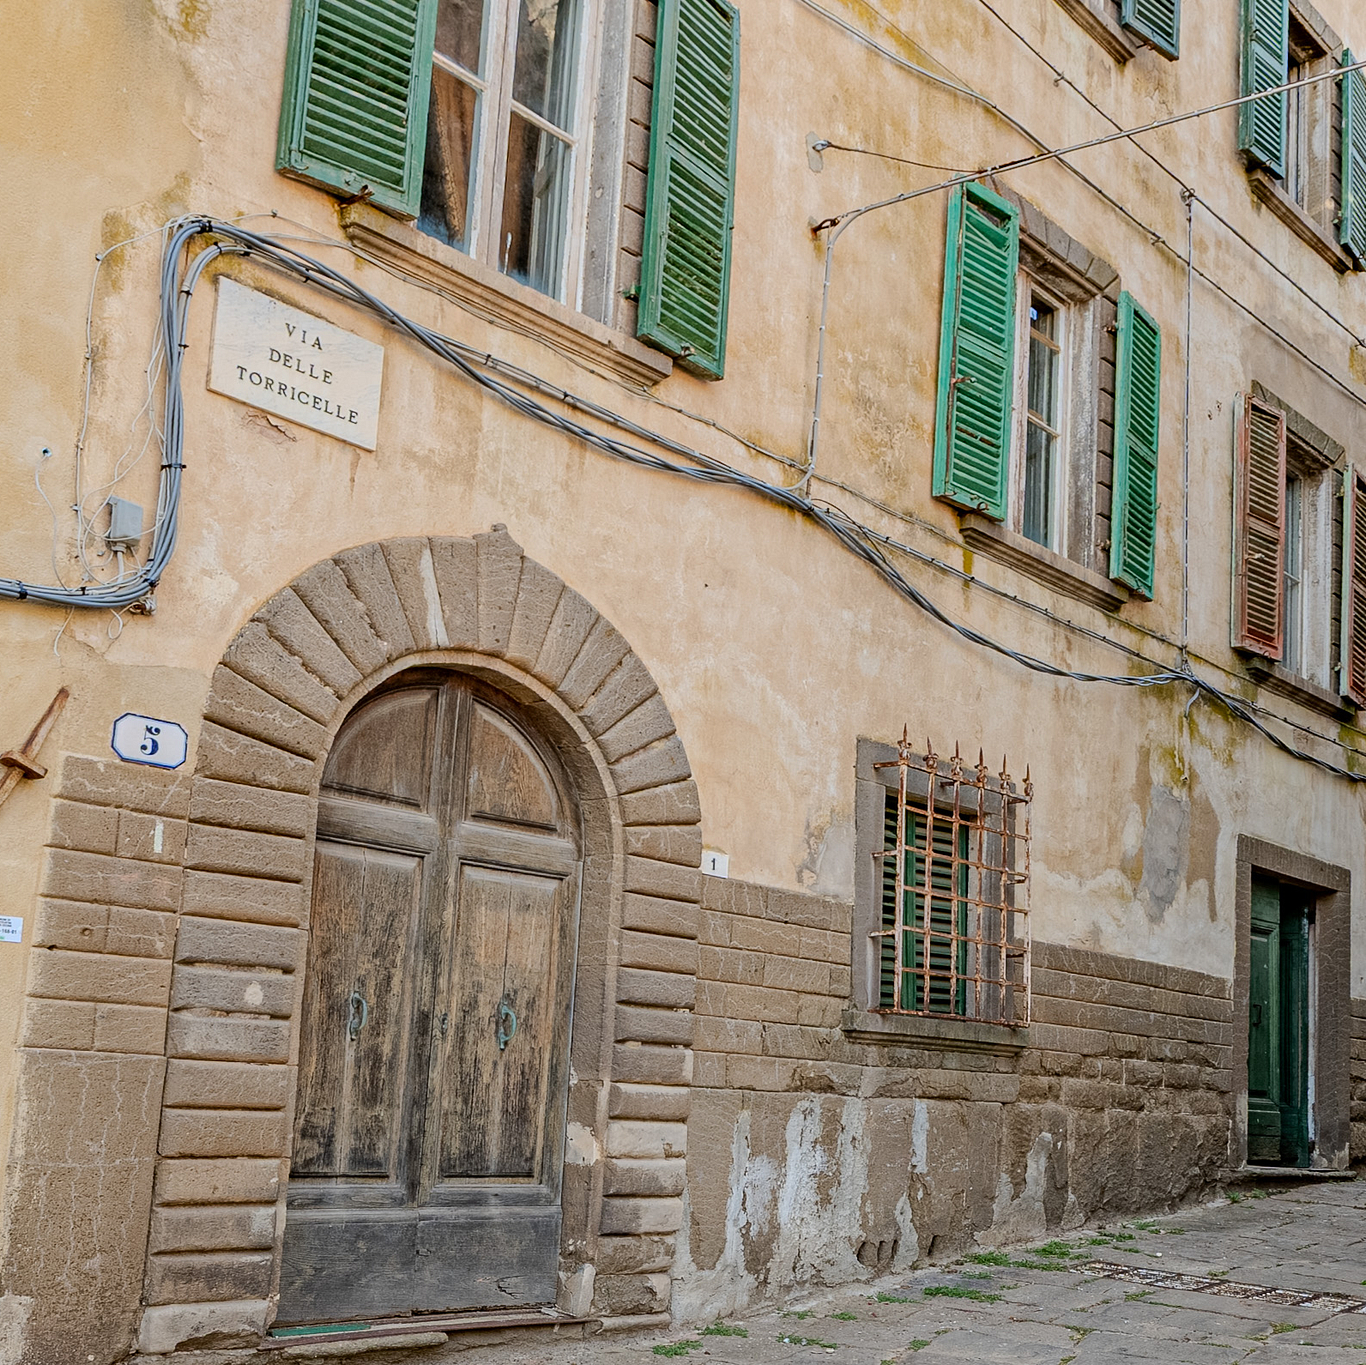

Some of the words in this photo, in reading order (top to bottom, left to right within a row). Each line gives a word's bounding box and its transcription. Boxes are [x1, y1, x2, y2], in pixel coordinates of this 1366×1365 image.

[285, 322, 323, 350] VIA
[269, 347, 333, 385] DELLE
[236, 365, 359, 425] TORRICELLE
[140, 725, 161, 755] 5
